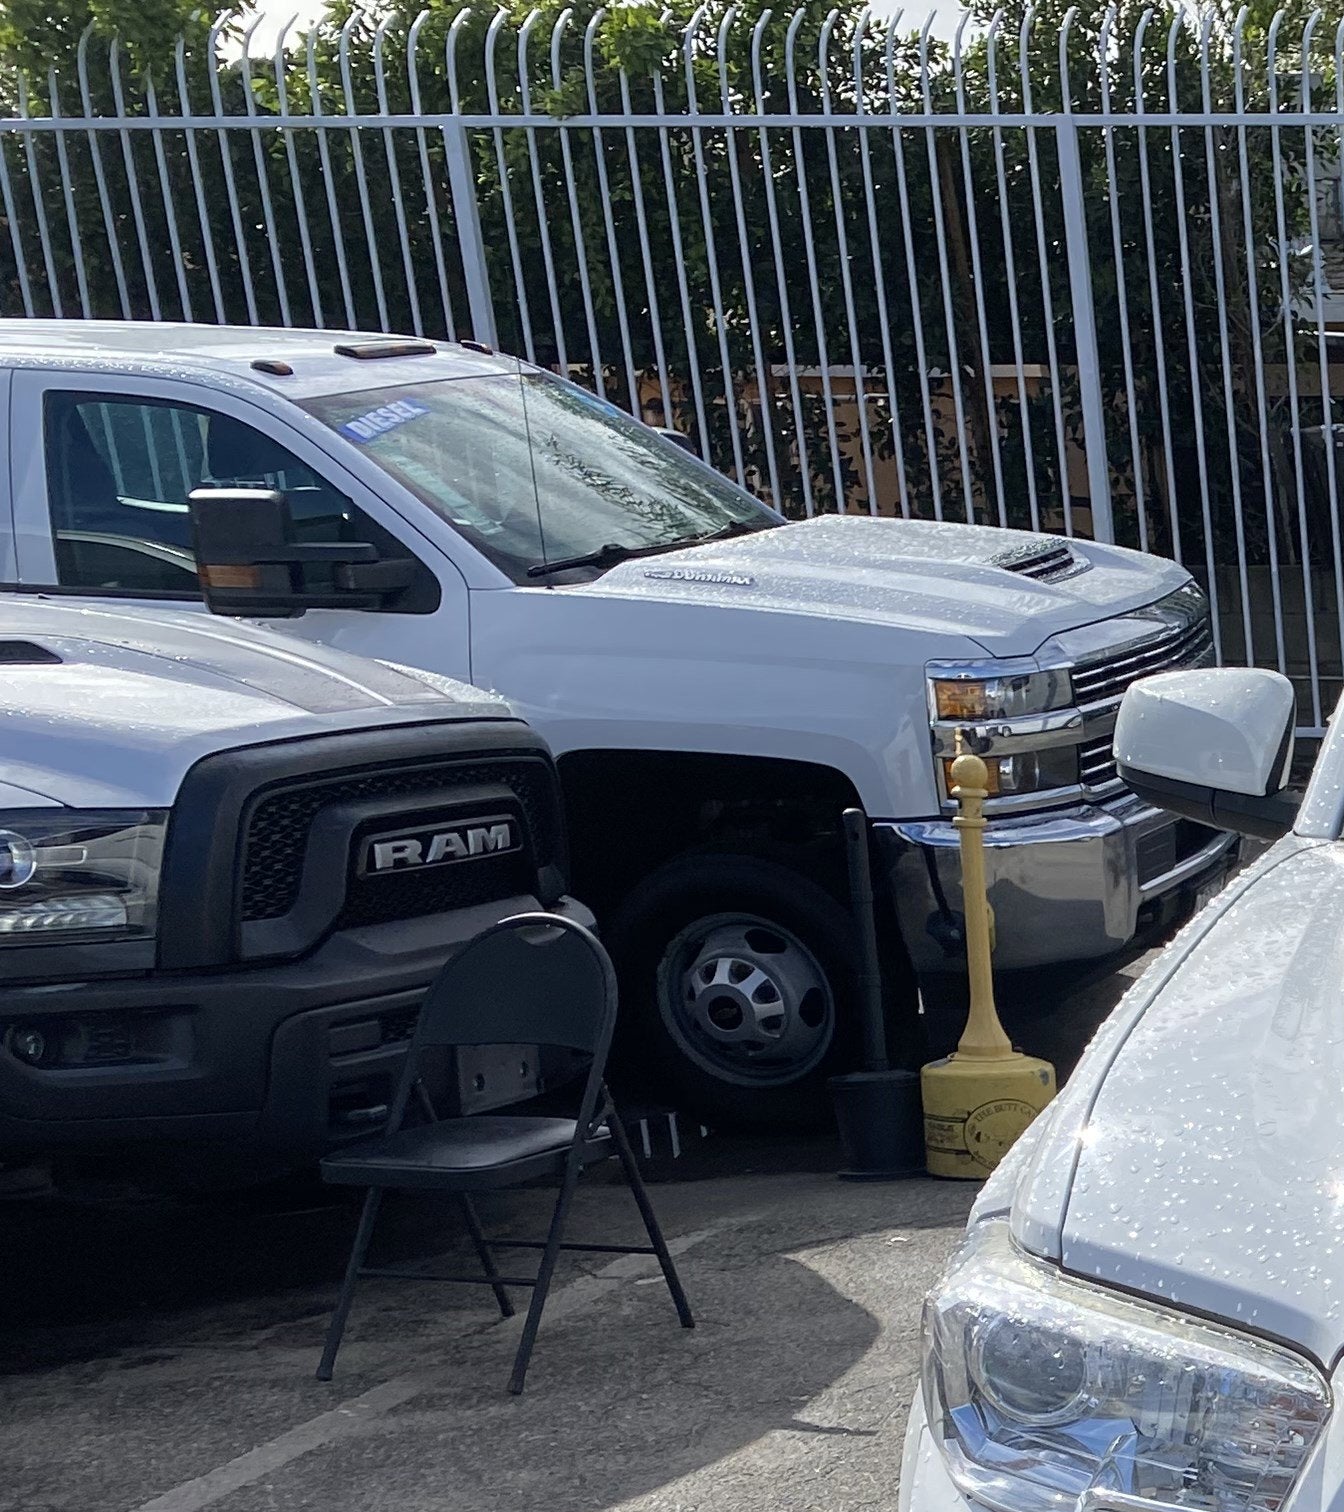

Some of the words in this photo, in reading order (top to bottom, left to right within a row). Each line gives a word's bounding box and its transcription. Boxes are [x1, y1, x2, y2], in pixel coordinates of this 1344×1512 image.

[345, 400, 427, 439] DIESEL
[374, 823, 511, 870] RAM
[975, 1107, 994, 1122] THE
[993, 1102, 1019, 1113] BUTT
